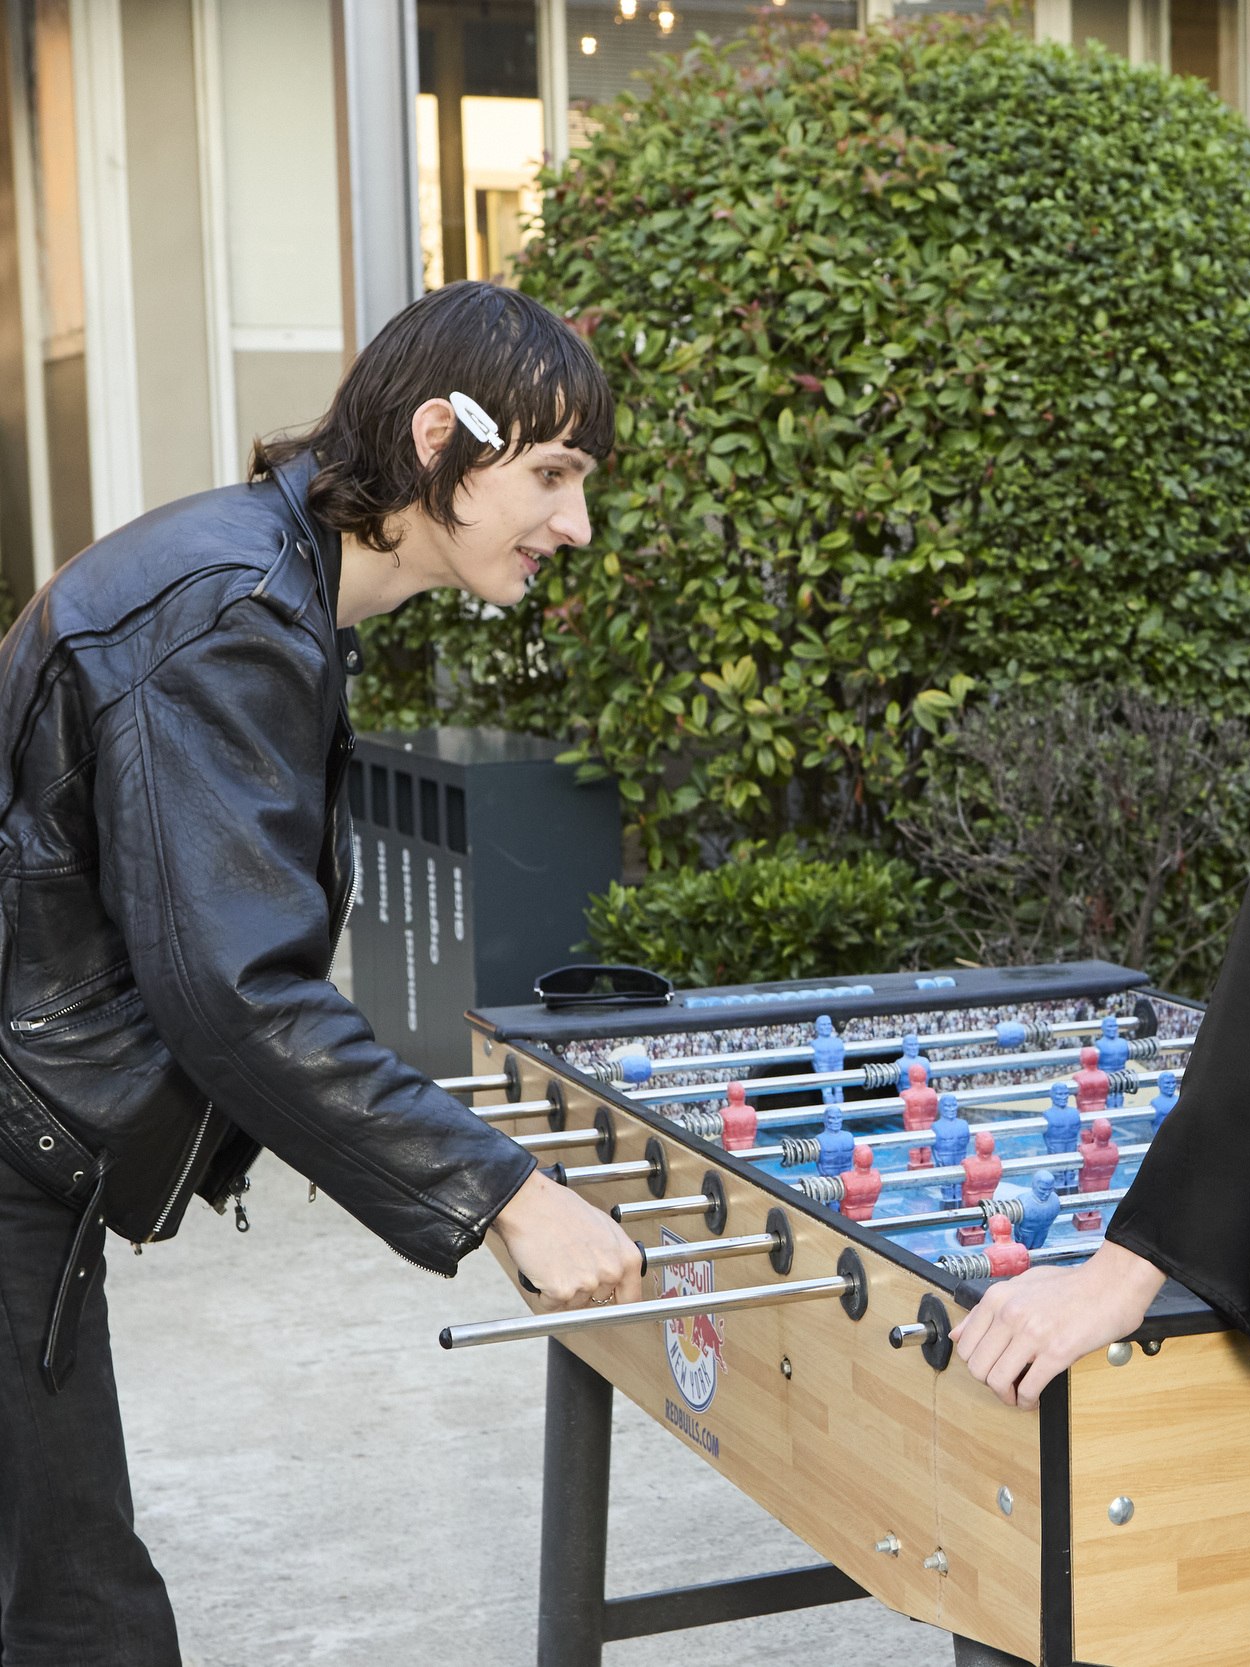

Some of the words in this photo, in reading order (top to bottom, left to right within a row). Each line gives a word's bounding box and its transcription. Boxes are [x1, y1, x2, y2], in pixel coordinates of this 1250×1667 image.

[377, 840, 389, 924] Plastic
[402, 848, 413, 924] waste
[427, 857, 439, 965] Organic
[453, 866, 464, 941] Glass
[404, 929, 418, 1032] General
[670, 1340, 688, 1388] NEW
[690, 1360, 712, 1399] YORK
[665, 1397, 720, 1459] REDBULLS.COM
